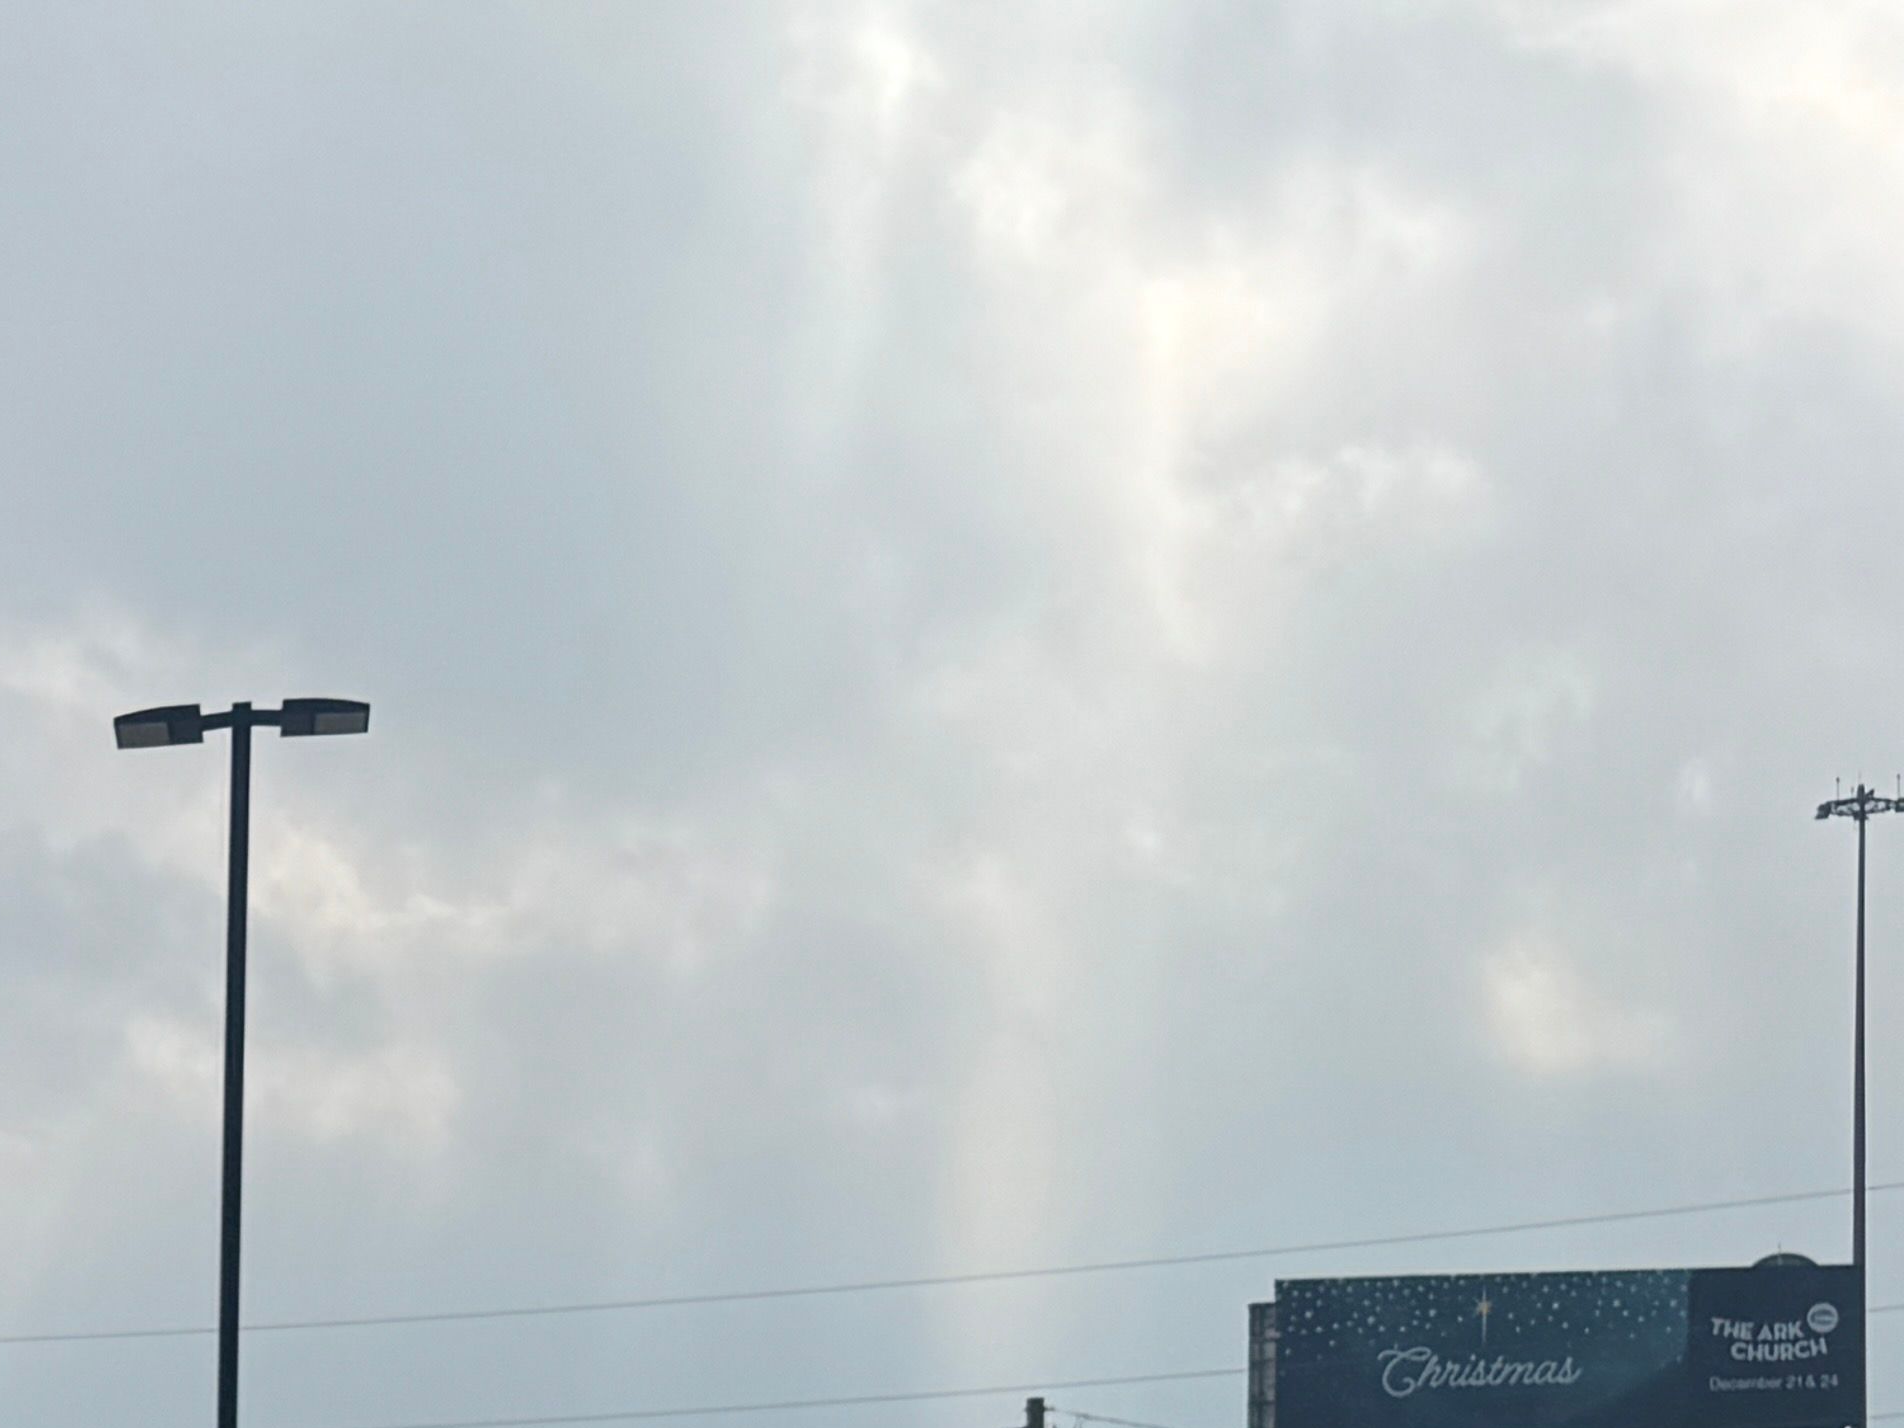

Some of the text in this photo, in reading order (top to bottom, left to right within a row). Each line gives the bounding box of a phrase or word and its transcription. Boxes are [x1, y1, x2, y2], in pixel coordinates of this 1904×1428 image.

[1710, 1316, 1805, 1341] THE ARK
[1730, 1336, 1829, 1362] CHURCH
[1376, 1346, 1583, 1397] Christmas
[1708, 1374, 1784, 1392] December
